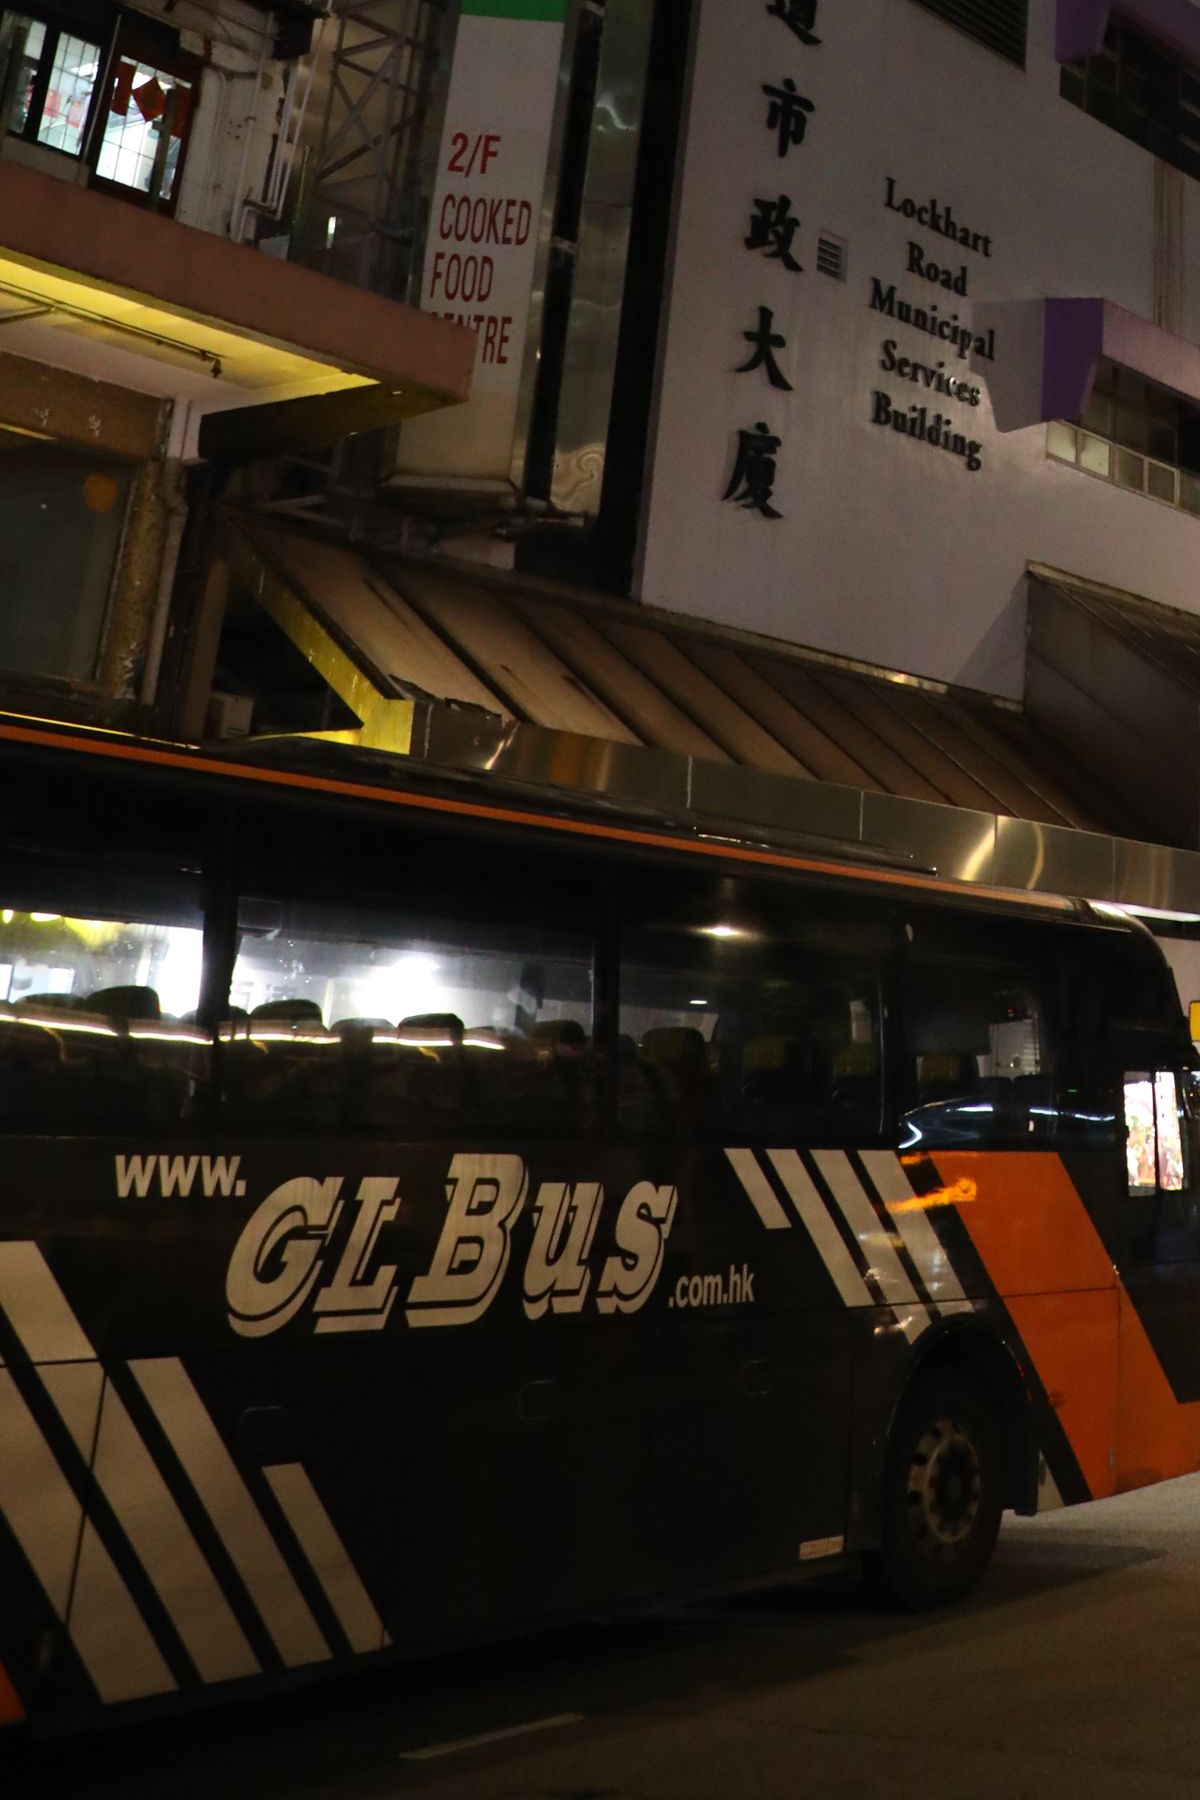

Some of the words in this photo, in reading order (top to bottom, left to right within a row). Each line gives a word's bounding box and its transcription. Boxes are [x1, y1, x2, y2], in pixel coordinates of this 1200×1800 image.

[447, 132, 501, 175] 2/F
[439, 193, 532, 246] COOKED
[883, 176, 993, 257] Lockhart
[431, 252, 494, 303] FOOD
[906, 241, 968, 297] Road
[869, 277, 995, 362] Municipal
[881, 339, 980, 407] Services
[871, 390, 983, 472] Building
[115, 1154, 247, 1198] www.
[668, 1262, 755, 1309] .com.hk
